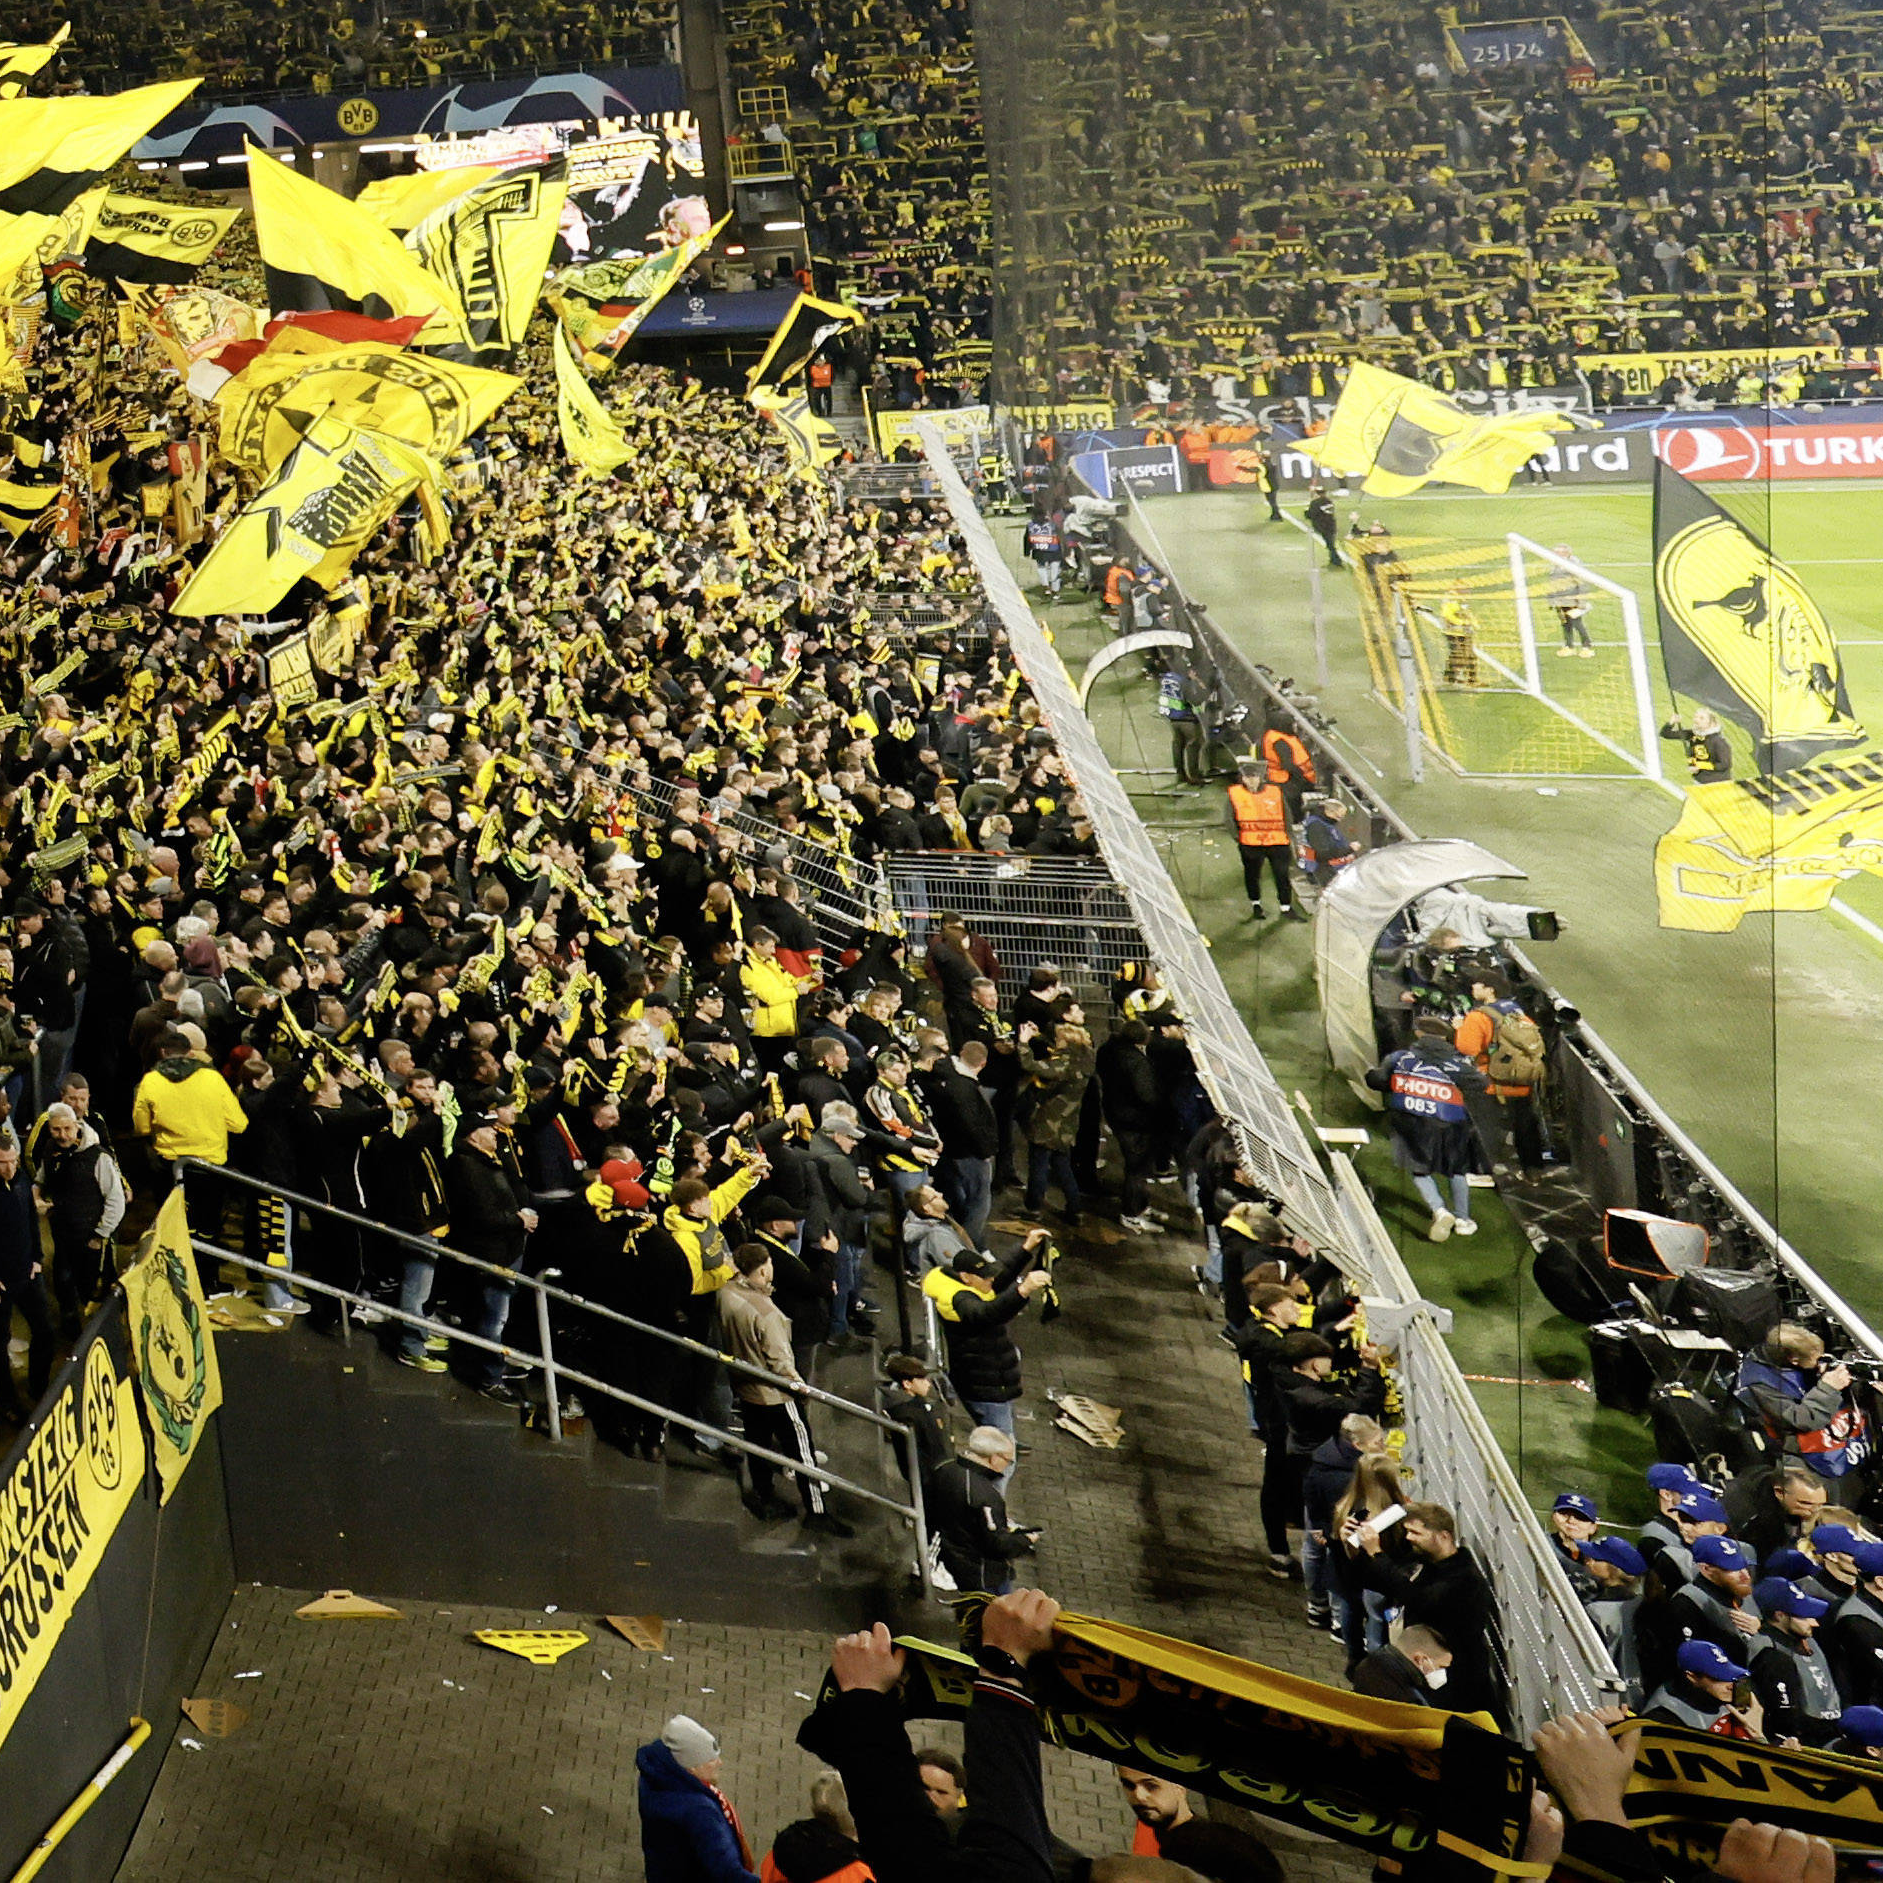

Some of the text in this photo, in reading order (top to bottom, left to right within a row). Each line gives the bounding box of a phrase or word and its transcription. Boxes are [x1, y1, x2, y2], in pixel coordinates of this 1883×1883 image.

[343, 101, 374, 125] BVB
[1123, 462, 1174, 478] RESPECT
[86, 1348, 119, 1456] BVB
[100, 1445, 116, 1482] 09
